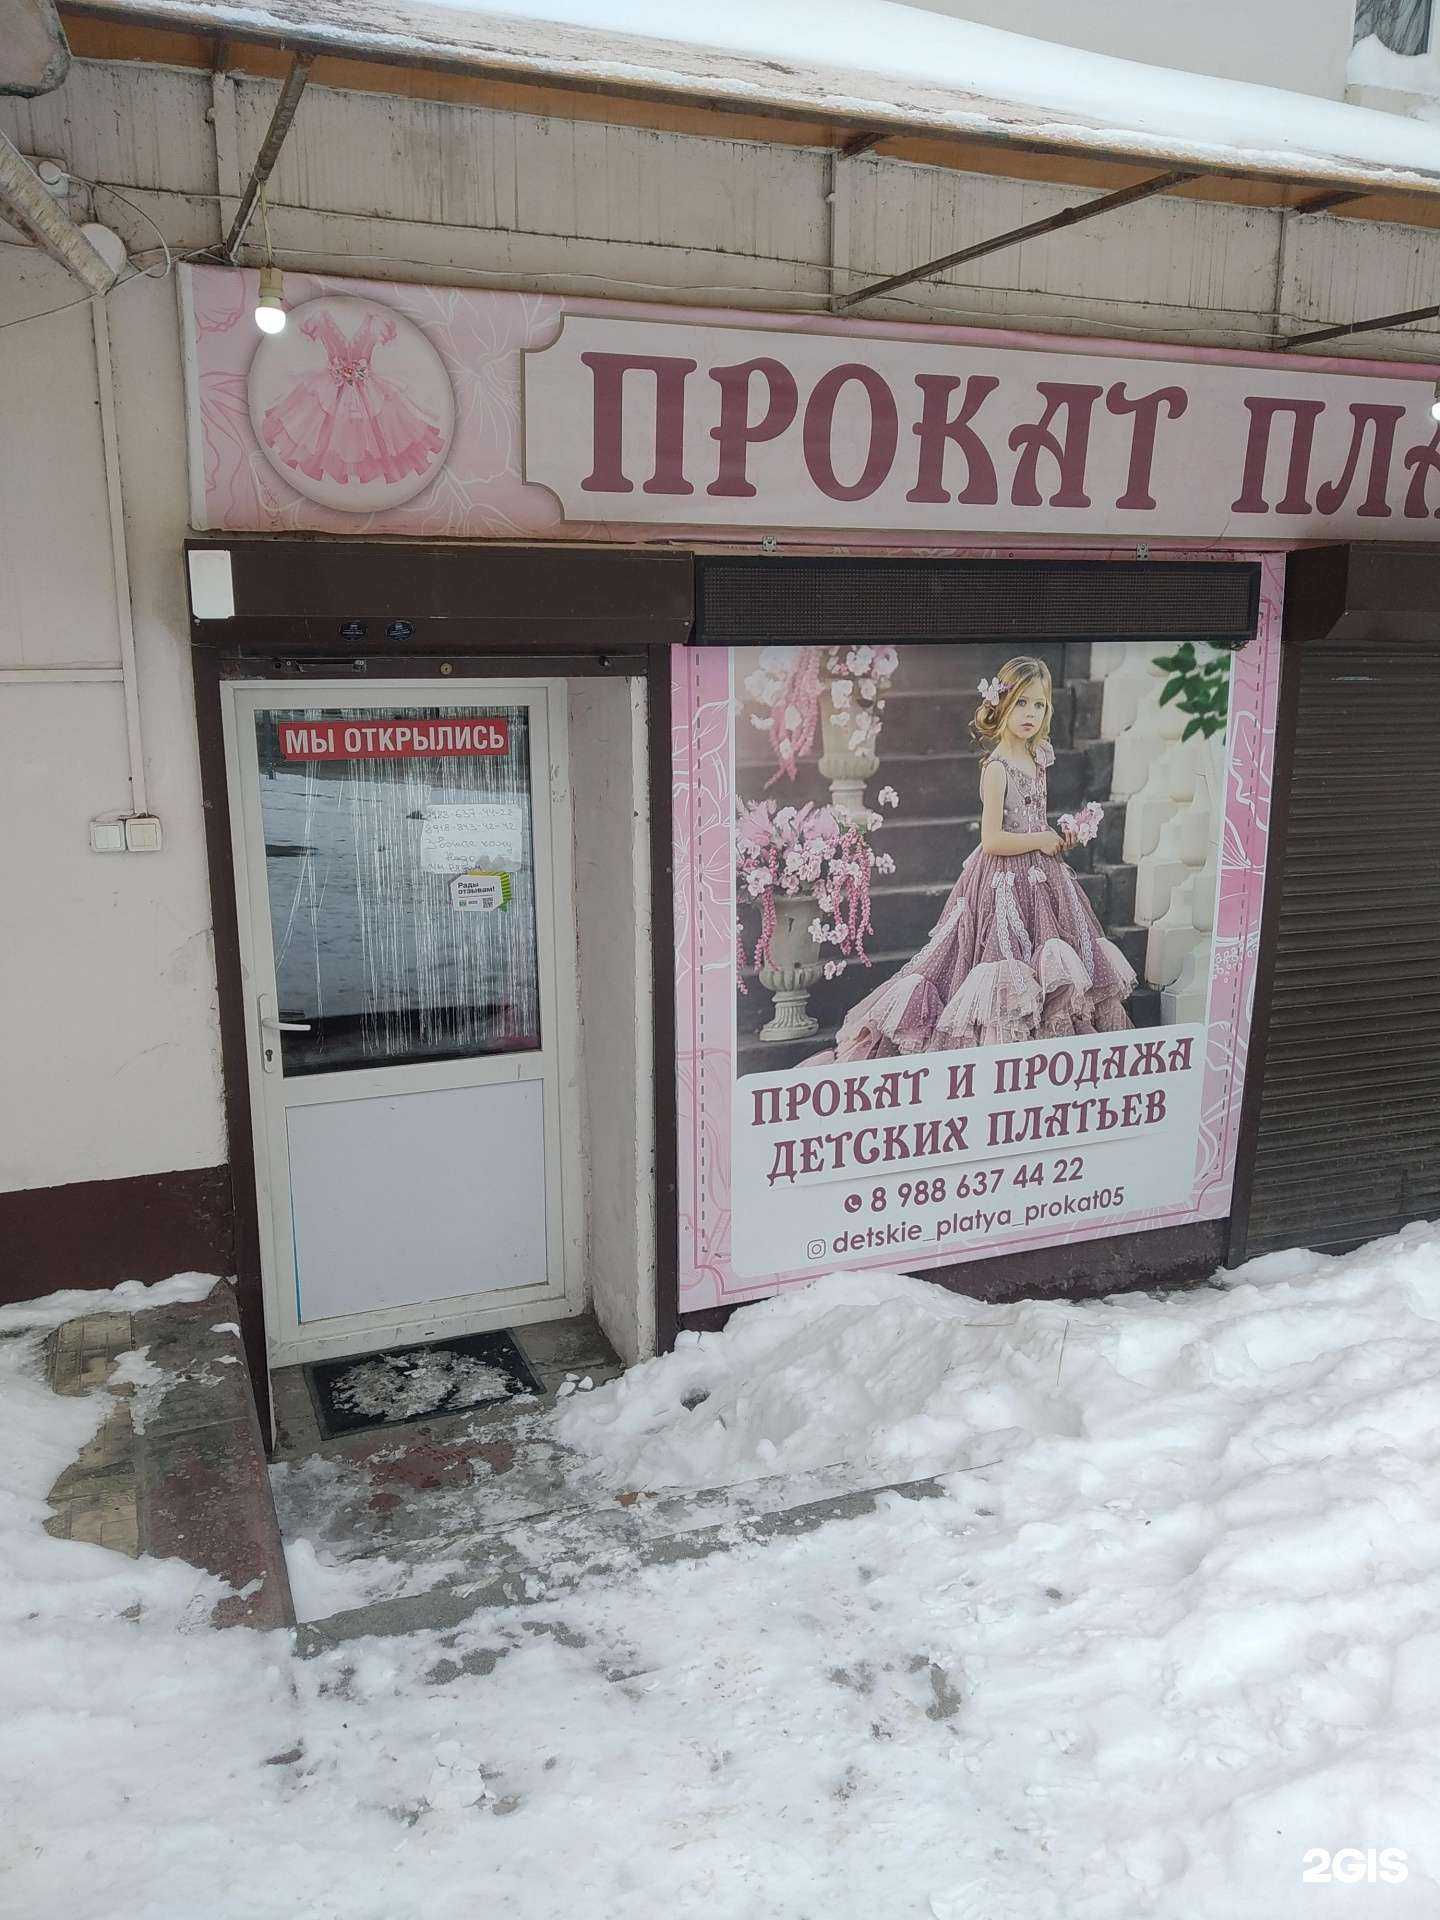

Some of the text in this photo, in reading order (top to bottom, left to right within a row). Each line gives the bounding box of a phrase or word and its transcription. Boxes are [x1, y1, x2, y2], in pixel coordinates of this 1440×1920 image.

[581, 351, 1188, 511] ПРОКАТ
[284, 725, 505, 754] МЫ ОТКРЫЛИСЬ
[458, 885, 495, 895] отзывам!
[751, 1037, 1195, 1125] ПРОКАТ И ПРОДАЖА
[766, 1089, 1167, 1187] ДЕТСКИХ ПЛАТЬЕВ
[870, 1156, 1084, 1213] 8 988 637 44 22
[832, 1186, 1125, 1254] detskie_platya_prokat05
